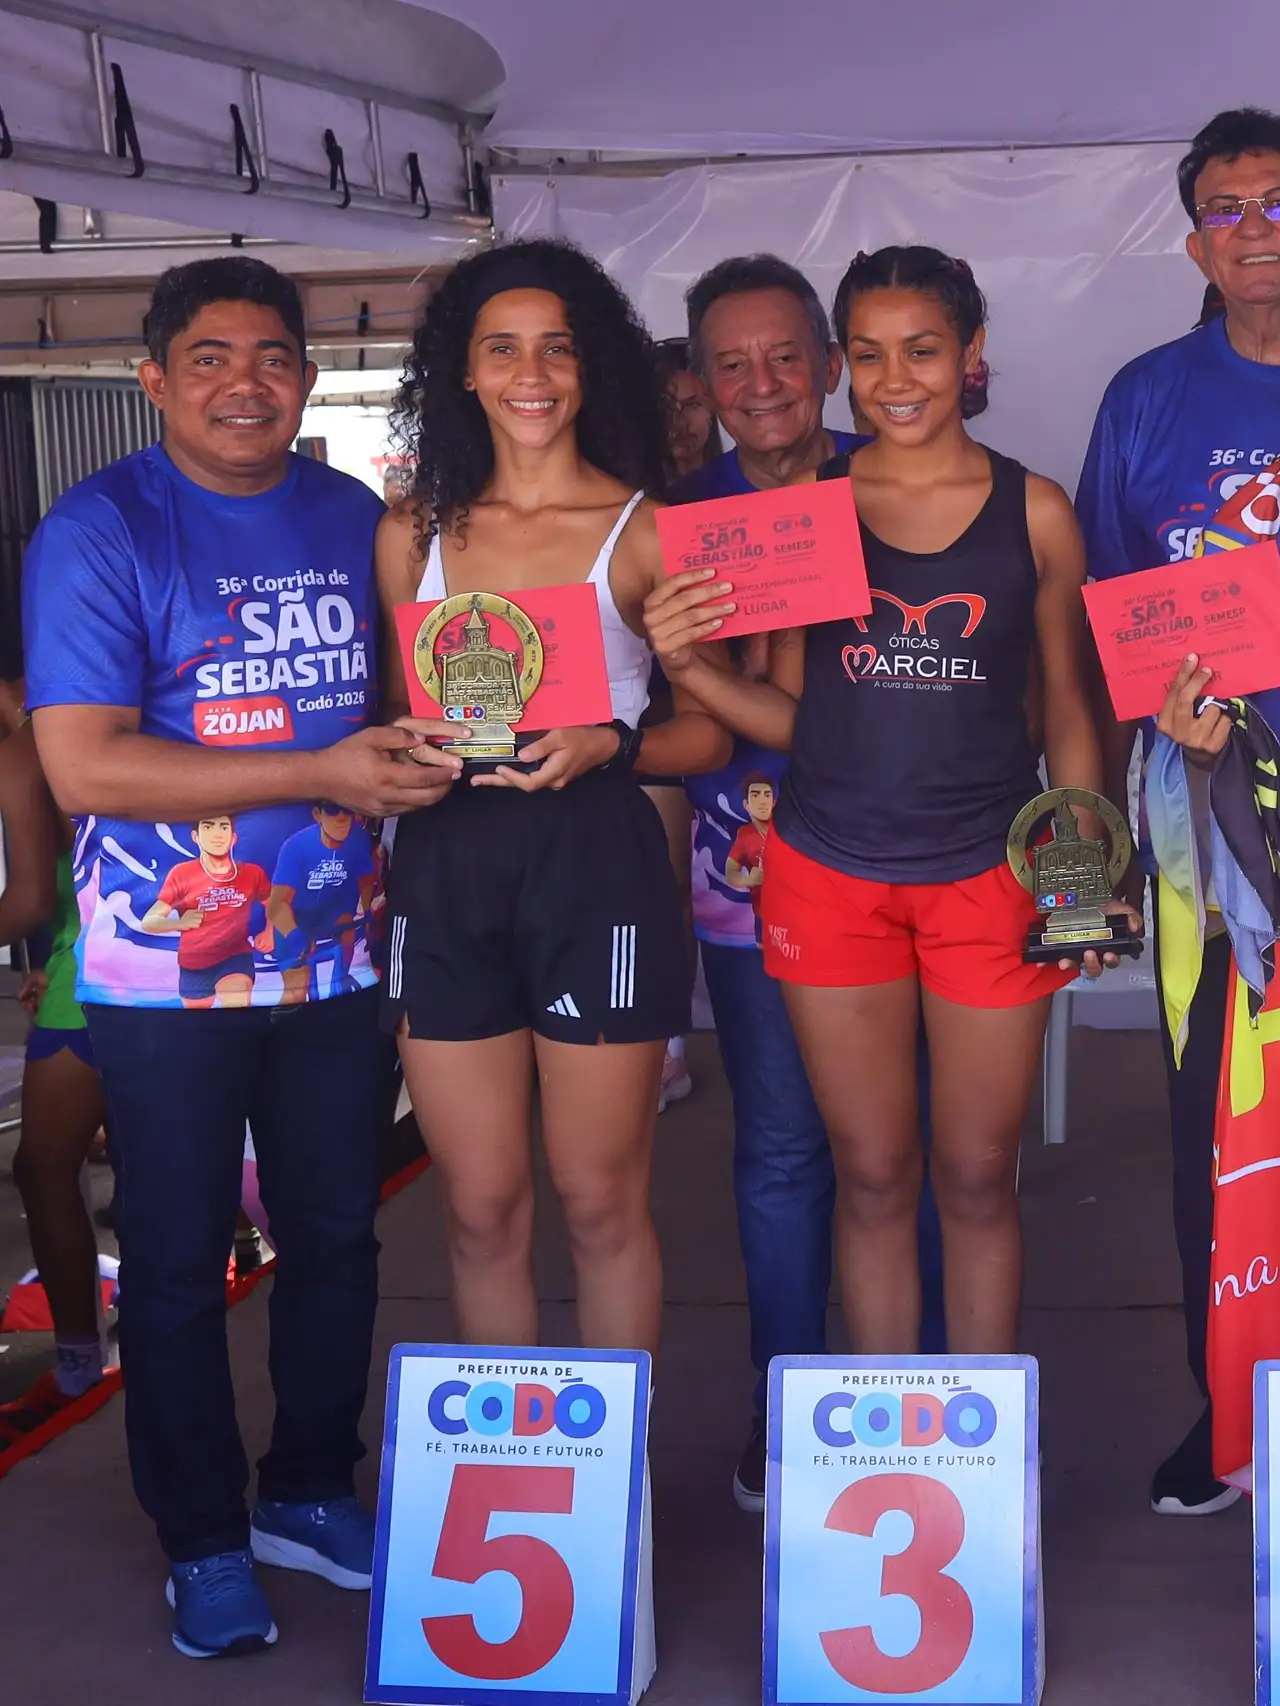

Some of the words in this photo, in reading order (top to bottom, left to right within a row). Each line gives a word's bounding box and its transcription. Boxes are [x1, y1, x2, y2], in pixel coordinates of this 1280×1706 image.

[1209, 449, 1254, 466] 36ª
[701, 526, 748, 552] SÃO
[773, 540, 817, 553] SEMESP
[683, 544, 764, 569] SEBASTIÃO
[216, 577, 247, 595] 36ª
[252, 569, 325, 592] Corrida
[328, 569, 349, 586] de
[744, 599, 788, 616] LUGAR
[1131, 599, 1176, 626] SÃO
[1204, 607, 1246, 625] SEMESP
[241, 589, 355, 654] SÃO
[1116, 615, 1194, 644] SEBASTIÃO
[888, 633, 940, 650] ÓTICAS
[903, 680, 914, 689] da
[916, 682, 930, 691] sua
[932, 682, 953, 692] visão
[297, 694, 333, 713] Codó
[335, 691, 365, 706] 2026
[458, 1364, 548, 1376] PREFEITURA
[554, 1367, 572, 1376] DE
[842, 1375, 936, 1386] PREFEITURA
[941, 1375, 960, 1385] DE
[427, 1377, 607, 1439] CODÓ
[812, 1385, 998, 1448] CODÓ
[426, 1440, 447, 1454] FÉ,
[452, 1442, 528, 1456] TRABALHO
[533, 1445, 540, 1456] E
[546, 1445, 604, 1458] FUTURO
[813, 1453, 834, 1467] FÉ,
[840, 1455, 917, 1467] TRABALHO
[924, 1455, 931, 1466] E
[937, 1455, 997, 1467] FUTURO
[420, 1463, 575, 1681] 5
[818, 1472, 974, 1695] 3
